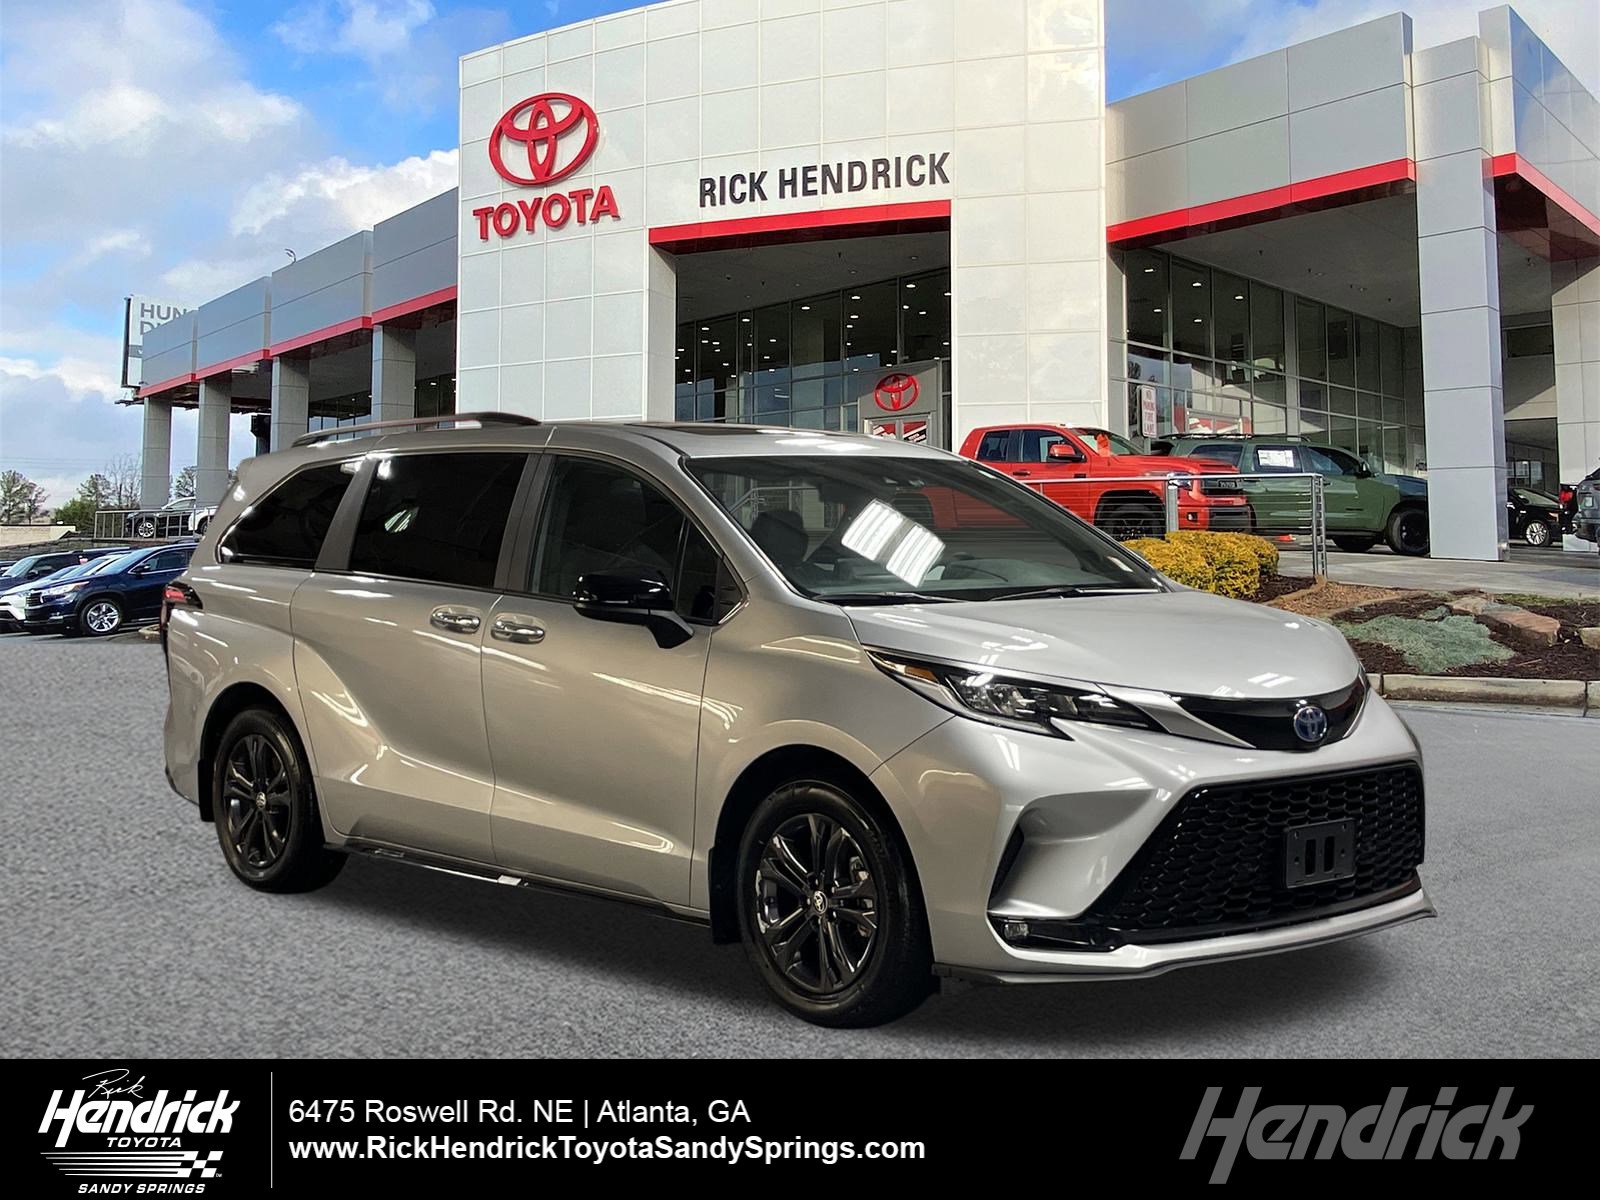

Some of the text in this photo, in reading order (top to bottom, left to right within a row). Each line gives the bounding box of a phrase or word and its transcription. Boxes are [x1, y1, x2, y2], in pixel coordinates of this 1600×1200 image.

[698, 152, 950, 208] RICK HENDRICK
[473, 185, 620, 240] TOYOTA
